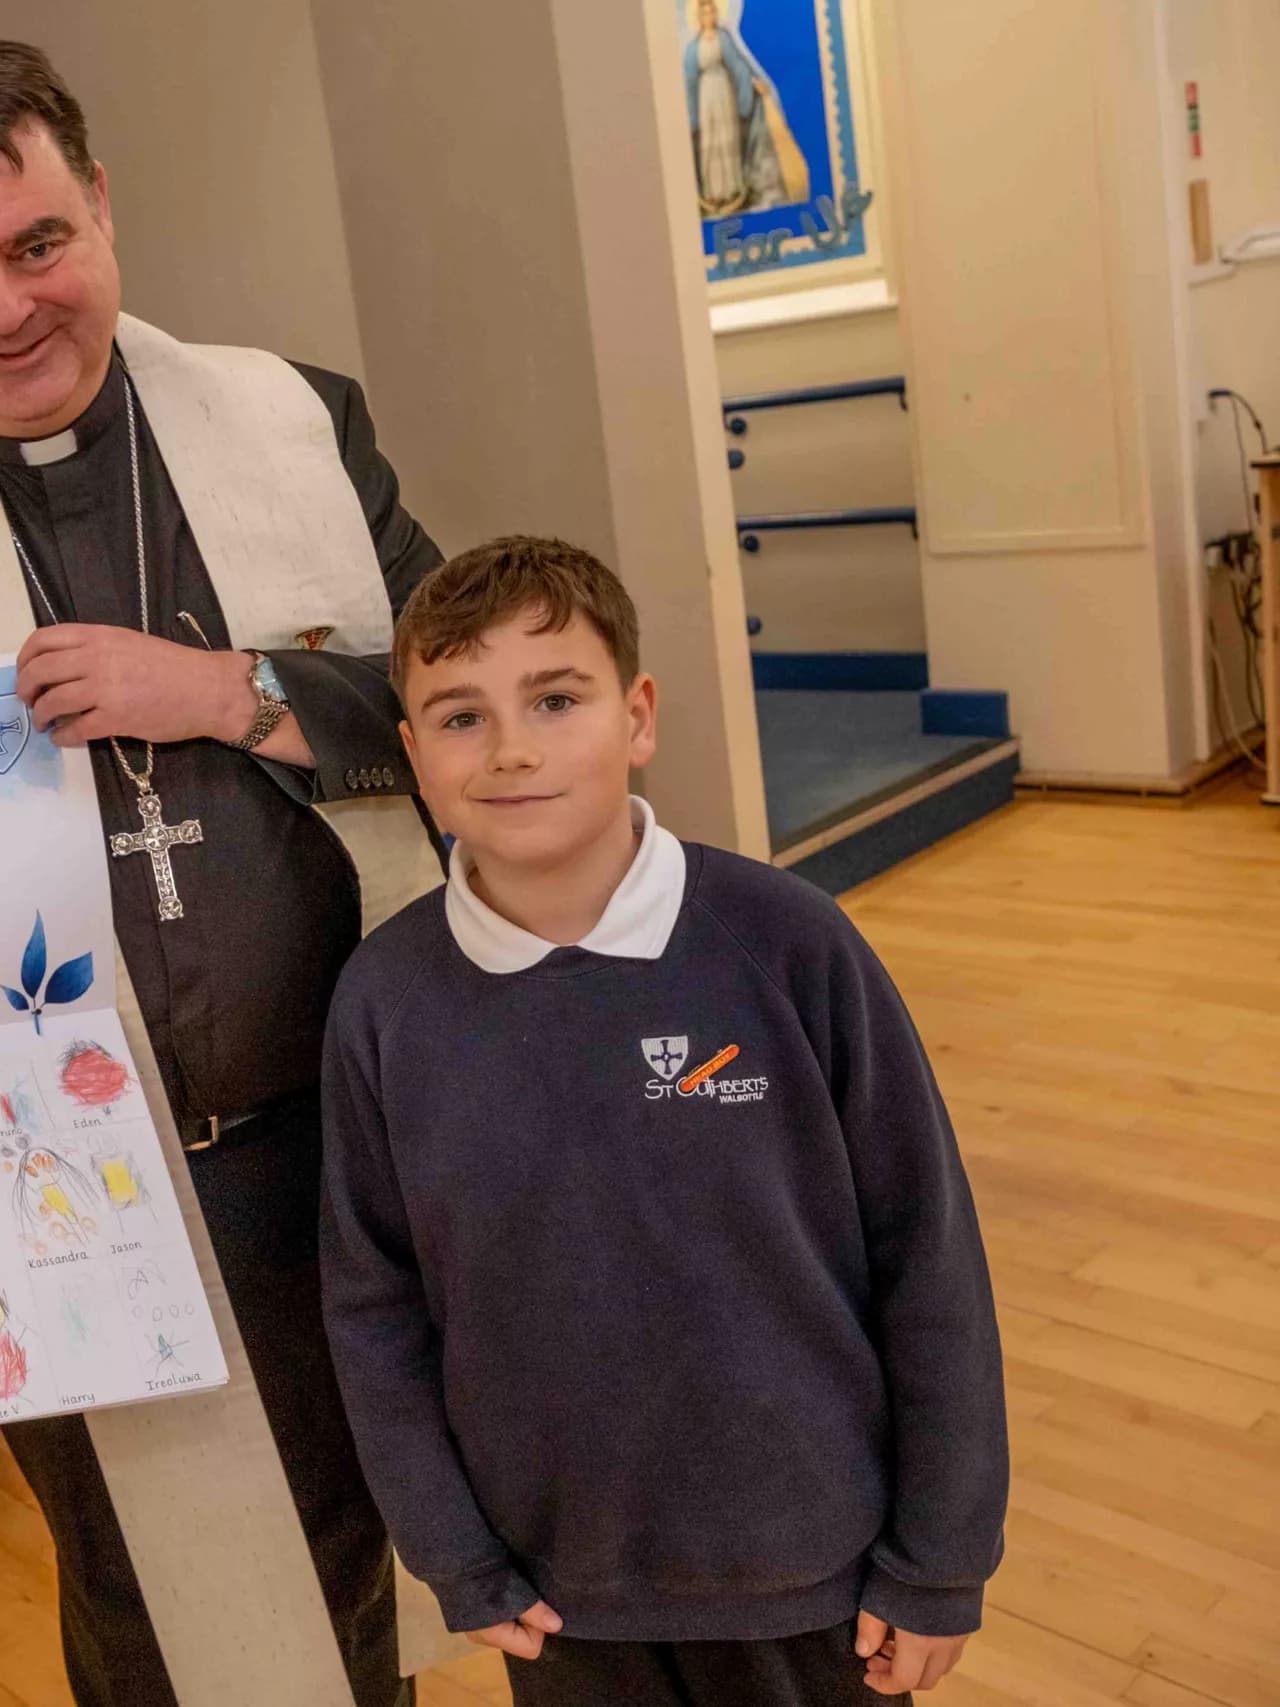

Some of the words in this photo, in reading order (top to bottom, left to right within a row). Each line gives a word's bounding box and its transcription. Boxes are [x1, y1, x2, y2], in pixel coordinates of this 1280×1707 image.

[719, 1091, 764, 1103] WALBOTTLE
[73, 1118, 102, 1129] Eden
[110, 1240, 142, 1254] Jason
[28, 1250, 88, 1269] Kassandra
[61, 1392, 96, 1405] Harry
[13, 1405, 19, 1415] V
